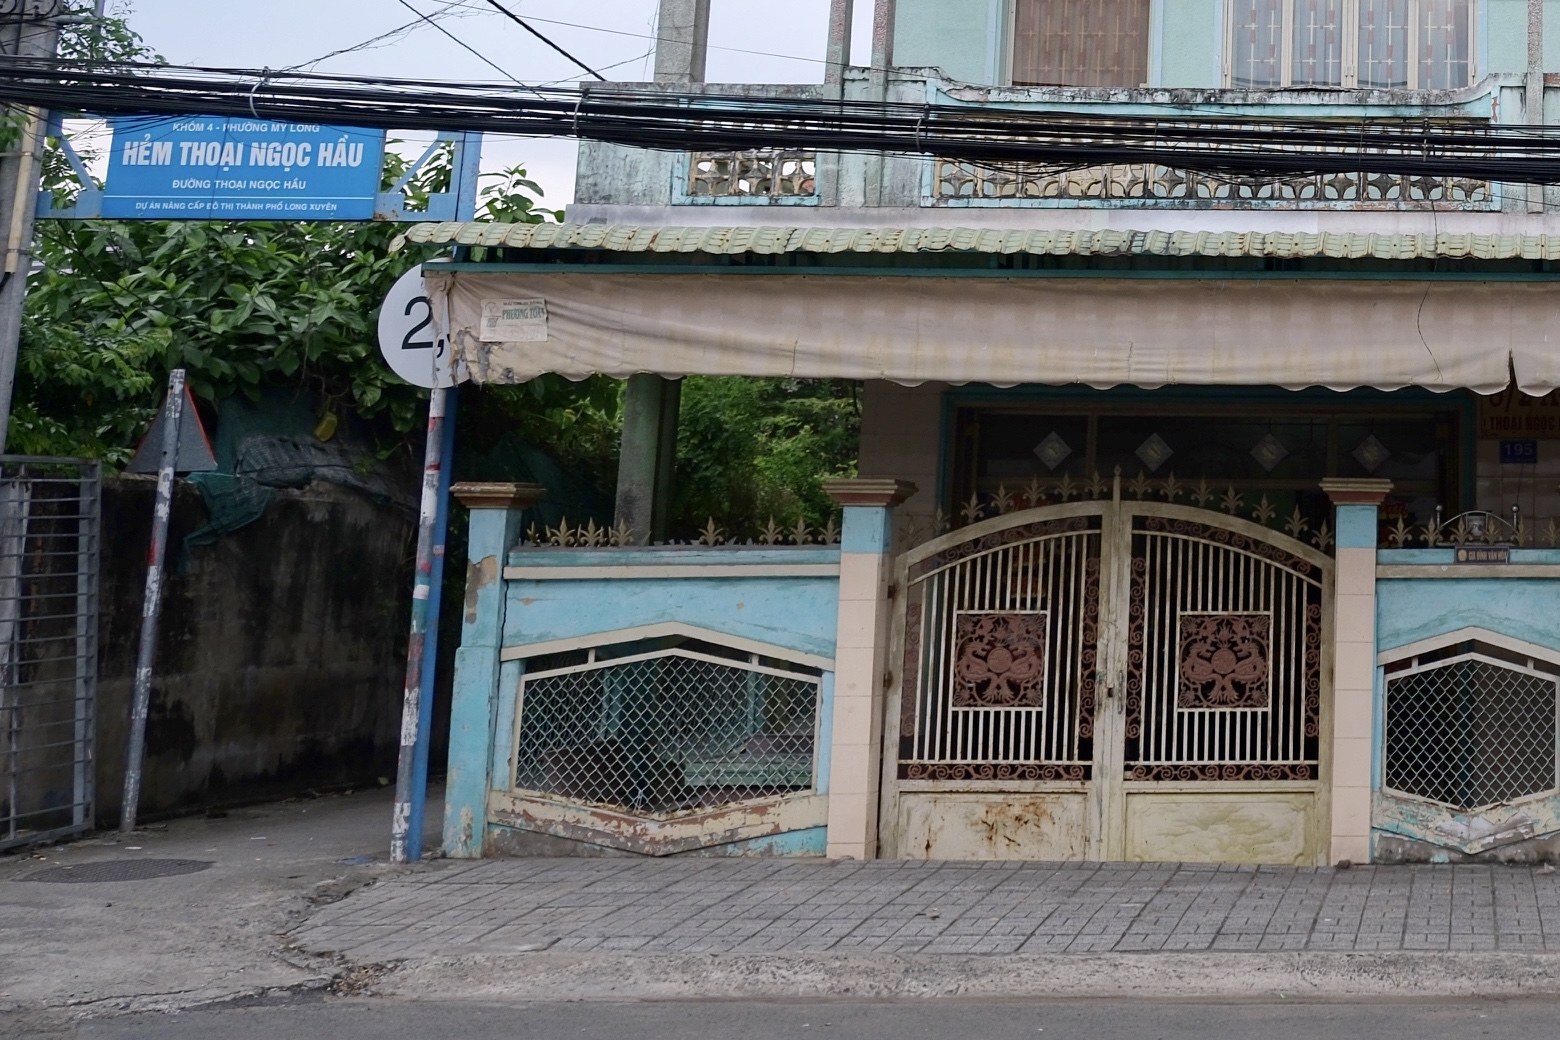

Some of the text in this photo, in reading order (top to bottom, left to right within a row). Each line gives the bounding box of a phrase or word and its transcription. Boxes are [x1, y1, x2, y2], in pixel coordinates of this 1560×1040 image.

[207, 123, 213, 132] 4
[289, 124, 320, 133] LONG
[180, 141, 244, 172] THOẠI
[249, 141, 312, 172] NGỌC
[317, 134, 364, 167] HẦU
[214, 179, 247, 191] THOẠI
[249, 179, 281, 191] NGỌC
[187, 200, 205, 210] CẤP
[235, 201, 264, 210] THÀNH
[265, 201, 283, 210] PHỐ
[284, 203, 308, 211] LONG
[309, 202, 338, 211] XUYÊN
[1504, 443, 1533, 456] 195
